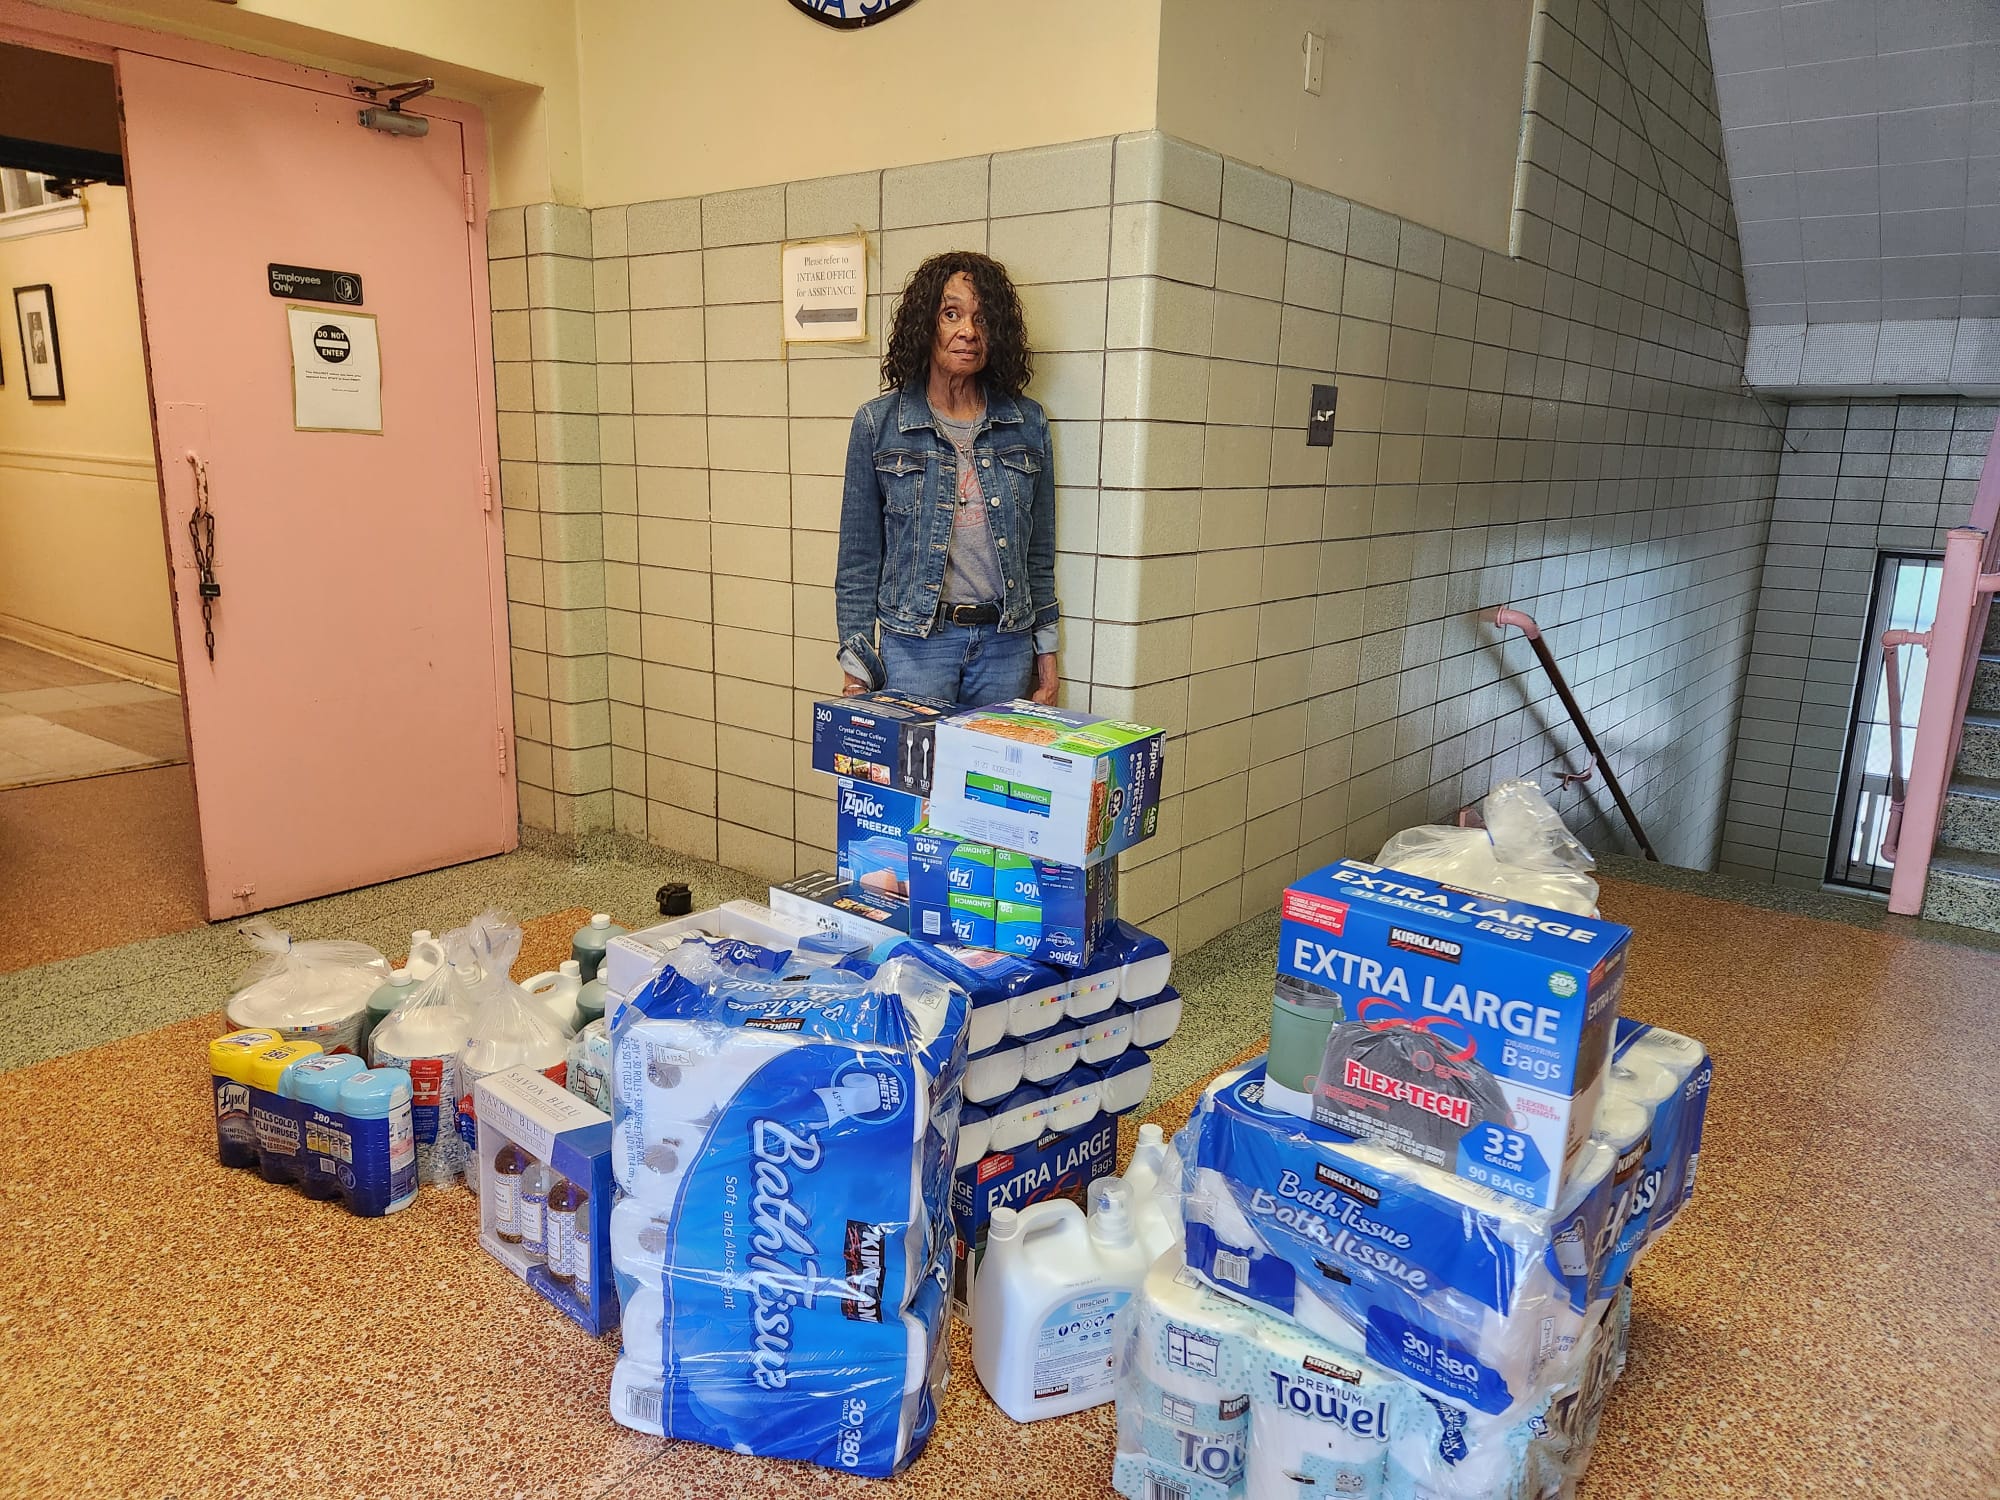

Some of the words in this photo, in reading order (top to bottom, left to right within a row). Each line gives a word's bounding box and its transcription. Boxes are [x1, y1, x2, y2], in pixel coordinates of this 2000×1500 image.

[804, 257, 823, 266] Please
[823, 255, 839, 265] refer
[272, 270, 321, 285] Employees
[797, 272, 826, 283] INTAKE
[826, 270, 857, 280] OFFICE
[273, 281, 294, 294] Only
[796, 288, 806, 298] for
[317, 330, 328, 339] DO
[330, 332, 345, 340] NOT
[322, 349, 345, 358] ENTER
[816, 708, 832, 722] 360
[851, 716, 875, 726] KIRKLAND
[838, 725, 855, 735] Crystal
[855, 729, 868, 738] Clear
[868, 732, 887, 742] Cutlery
[992, 783, 1004, 793] 120
[1012, 787, 1048, 804] SANDWICH
[1111, 792, 1121, 815] 3X
[1127, 752, 1143, 837] PROTECTION
[844, 792, 884, 818] Ziploc
[856, 817, 902, 837] FREEZER
[1147, 807, 1157, 834] 480
[916, 842, 939, 854] 480
[998, 851, 1011, 861] 120
[922, 863, 931, 872] 4
[954, 896, 992, 908] SANDWICH
[1351, 889, 1376, 901] 33
[1379, 894, 1454, 919] GALLON
[1441, 884, 1510, 903] KIRKLAND
[999, 905, 1013, 914] 120
[1331, 870, 1450, 908] EXTRA
[1459, 902, 1598, 944] LARGE
[1475, 920, 1534, 942] Bags
[1391, 928, 1462, 957] KIRKLAND
[1049, 950, 1080, 964] Ziploc
[1294, 938, 1411, 1004] EXTRA
[1423, 976, 1560, 1044] LARGE
[1549, 975, 1577, 989] 20%
[726, 999, 786, 1017] Tissue
[744, 1021, 801, 1031] KIRKLAND
[622, 1050, 631, 1061] SQ
[1504, 1038, 1560, 1060] DRAWSTRING
[622, 1061, 632, 1070] FT
[633, 1060, 642, 1069] 30
[1502, 1046, 1562, 1081] Bags
[633, 1070, 642, 1092] ROLLS
[877, 1072, 892, 1111] SHEETS
[887, 1076, 901, 1105] WIDE
[219, 1087, 248, 1112] Lysol
[508, 1072, 545, 1096] SAVON
[546, 1096, 582, 1117] BLEU
[1345, 1058, 1472, 1128] FLEX-TECH
[480, 1090, 513, 1119] SAVON
[519, 1114, 546, 1140] BLEU
[633, 1098, 643, 1111] 380
[1516, 1097, 1555, 1112] FLEXIBLE
[1516, 1103, 1560, 1121] STRENGTH
[253, 1109, 273, 1122] KILLS
[273, 1116, 293, 1128] COLD
[292, 1122, 298, 1130] &
[312, 1111, 330, 1124] 380
[633, 1112, 643, 1137] SHEETS
[255, 1121, 269, 1132] FLU
[269, 1124, 298, 1139] VIRUSES
[1038, 1133, 1059, 1148] KIRKL
[636, 1137, 644, 1150] PER
[1483, 1127, 1527, 1162] 33
[637, 1151, 645, 1166] ROLL
[1091, 1156, 1113, 1177] Bags
[1483, 1154, 1523, 1172] GALLON
[987, 1162, 1052, 1213] EXTRA
[1055, 1127, 1111, 1177] LARGE
[723, 1175, 738, 1208] Soft
[752, 1119, 822, 1257] Bath
[1317, 1165, 1379, 1201] KIRKLAND
[1468, 1165, 1487, 1182] 90
[1490, 1170, 1536, 1200] BAGS
[1278, 1170, 1339, 1223] Bath
[1338, 1194, 1412, 1250] Tissue
[722, 1211, 735, 1237] and
[1332, 1229, 1429, 1292] Tissue
[857, 1223, 881, 1323] KIRKLAN
[749, 1255, 818, 1390] Tissue
[1402, 1331, 1430, 1357] 30
[1435, 1349, 1480, 1383] 380
[1403, 1347, 1429, 1364] ROLLS
[1306, 1356, 1360, 1380] KIRKLAND
[1401, 1356, 1433, 1376] WIDE
[1434, 1373, 1479, 1400] SHEETS
[1036, 1384, 1069, 1396] KIRKLAND
[1297, 1375, 1363, 1405] PREMIUM
[848, 1398, 867, 1426] 30
[1223, 1395, 1248, 1413] KIRK
[1270, 1371, 1387, 1437] Towel
[841, 1429, 862, 1468] 380
